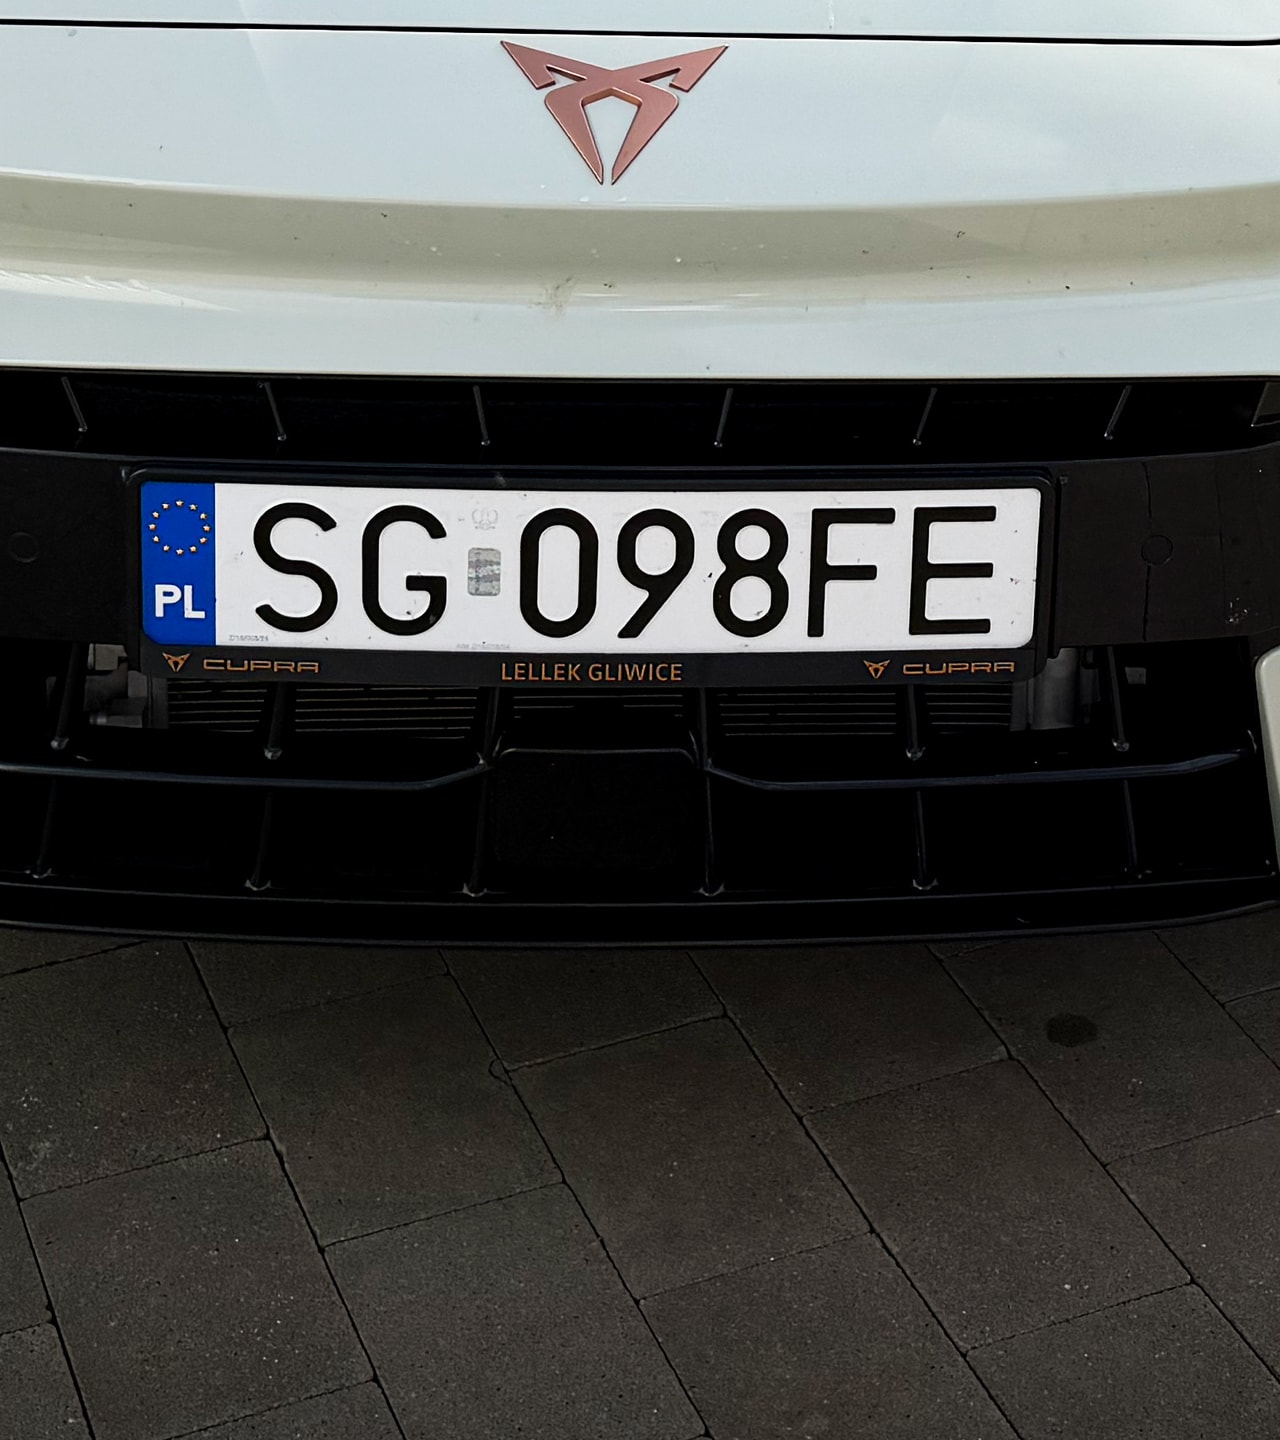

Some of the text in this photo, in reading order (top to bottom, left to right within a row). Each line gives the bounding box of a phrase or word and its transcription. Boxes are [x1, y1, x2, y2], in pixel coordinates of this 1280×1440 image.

[253, 502, 997, 639] SG 098FE
[155, 584, 206, 619] PL
[203, 659, 319, 673] CUPRA
[500, 663, 683, 681] LELLEK GLIWICE
[902, 661, 1016, 675] CUPRA
